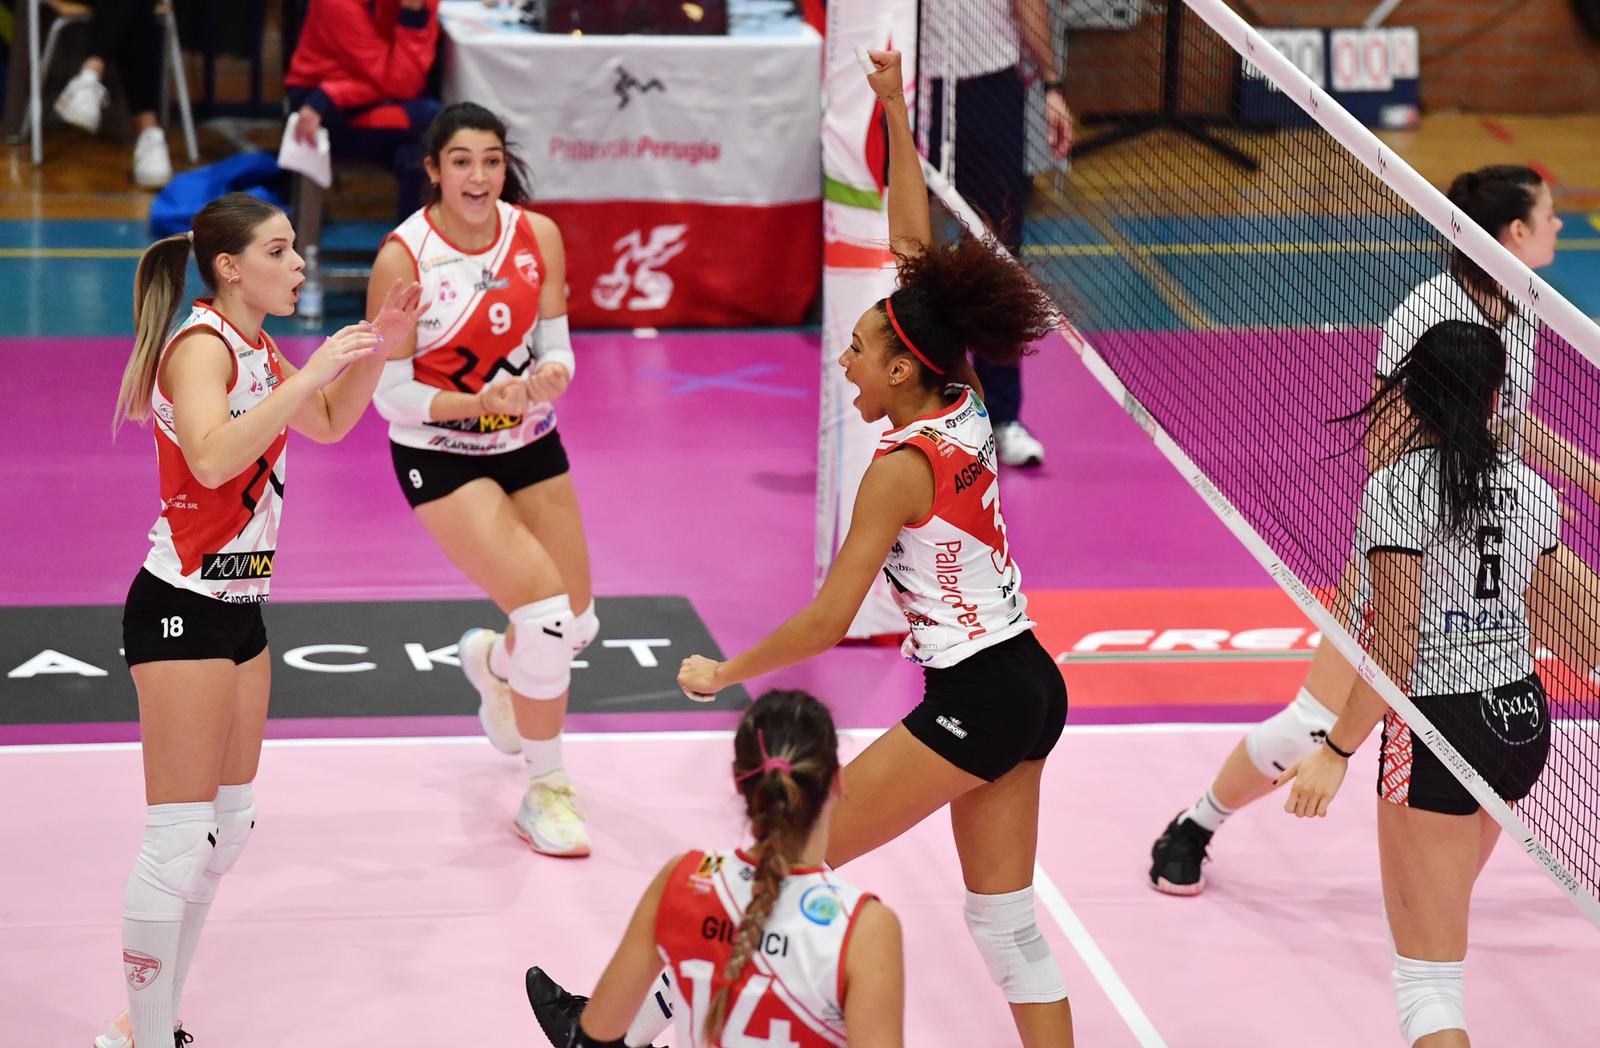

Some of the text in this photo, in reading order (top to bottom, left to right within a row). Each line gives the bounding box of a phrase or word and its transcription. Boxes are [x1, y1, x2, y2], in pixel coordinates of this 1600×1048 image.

[488, 302, 512, 335] 9
[408, 469, 424, 489] 9
[1475, 525, 1502, 599] 6
[160, 616, 184, 638] 18
[679, 959, 801, 1048] 14
